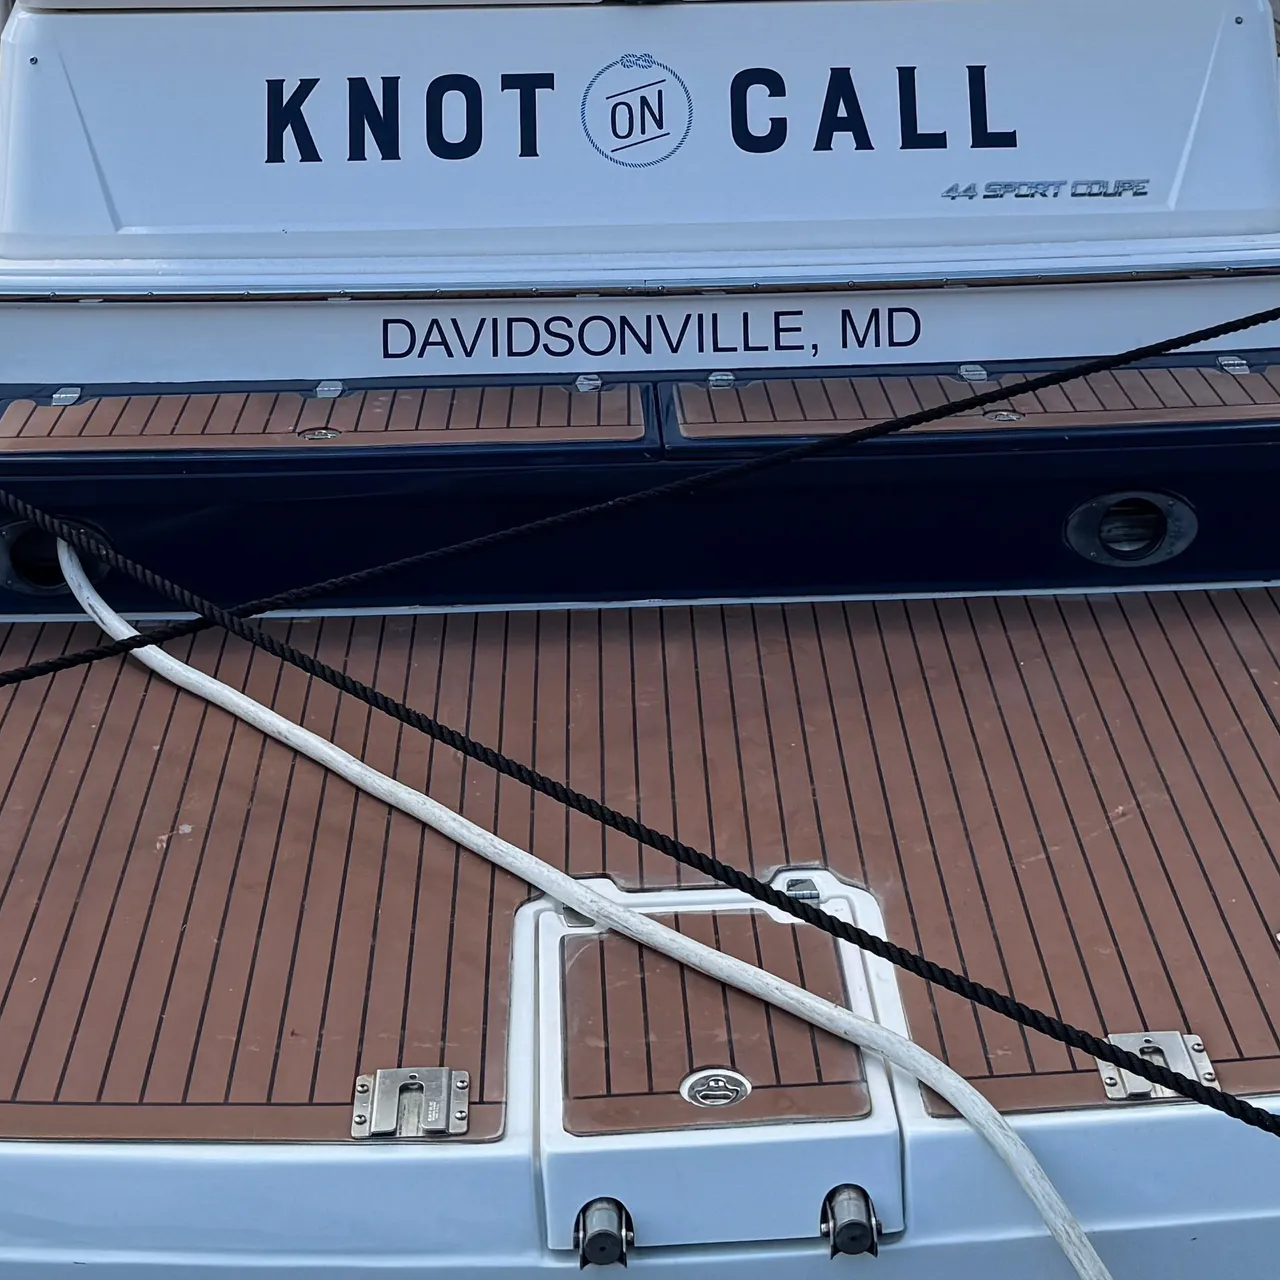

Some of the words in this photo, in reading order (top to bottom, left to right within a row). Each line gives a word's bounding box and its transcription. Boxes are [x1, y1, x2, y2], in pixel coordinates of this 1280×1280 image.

[265, 73, 554, 163] KNOT
[610, 89, 664, 140] ON
[731, 65, 1017, 153] CALL
[941, 182, 978, 201] 44
[982, 180, 1067, 200] SPORT
[1070, 178, 1150, 198] COUPE
[383, 310, 819, 361] DAVIDSONVILLE,
[842, 307, 920, 349] MD
